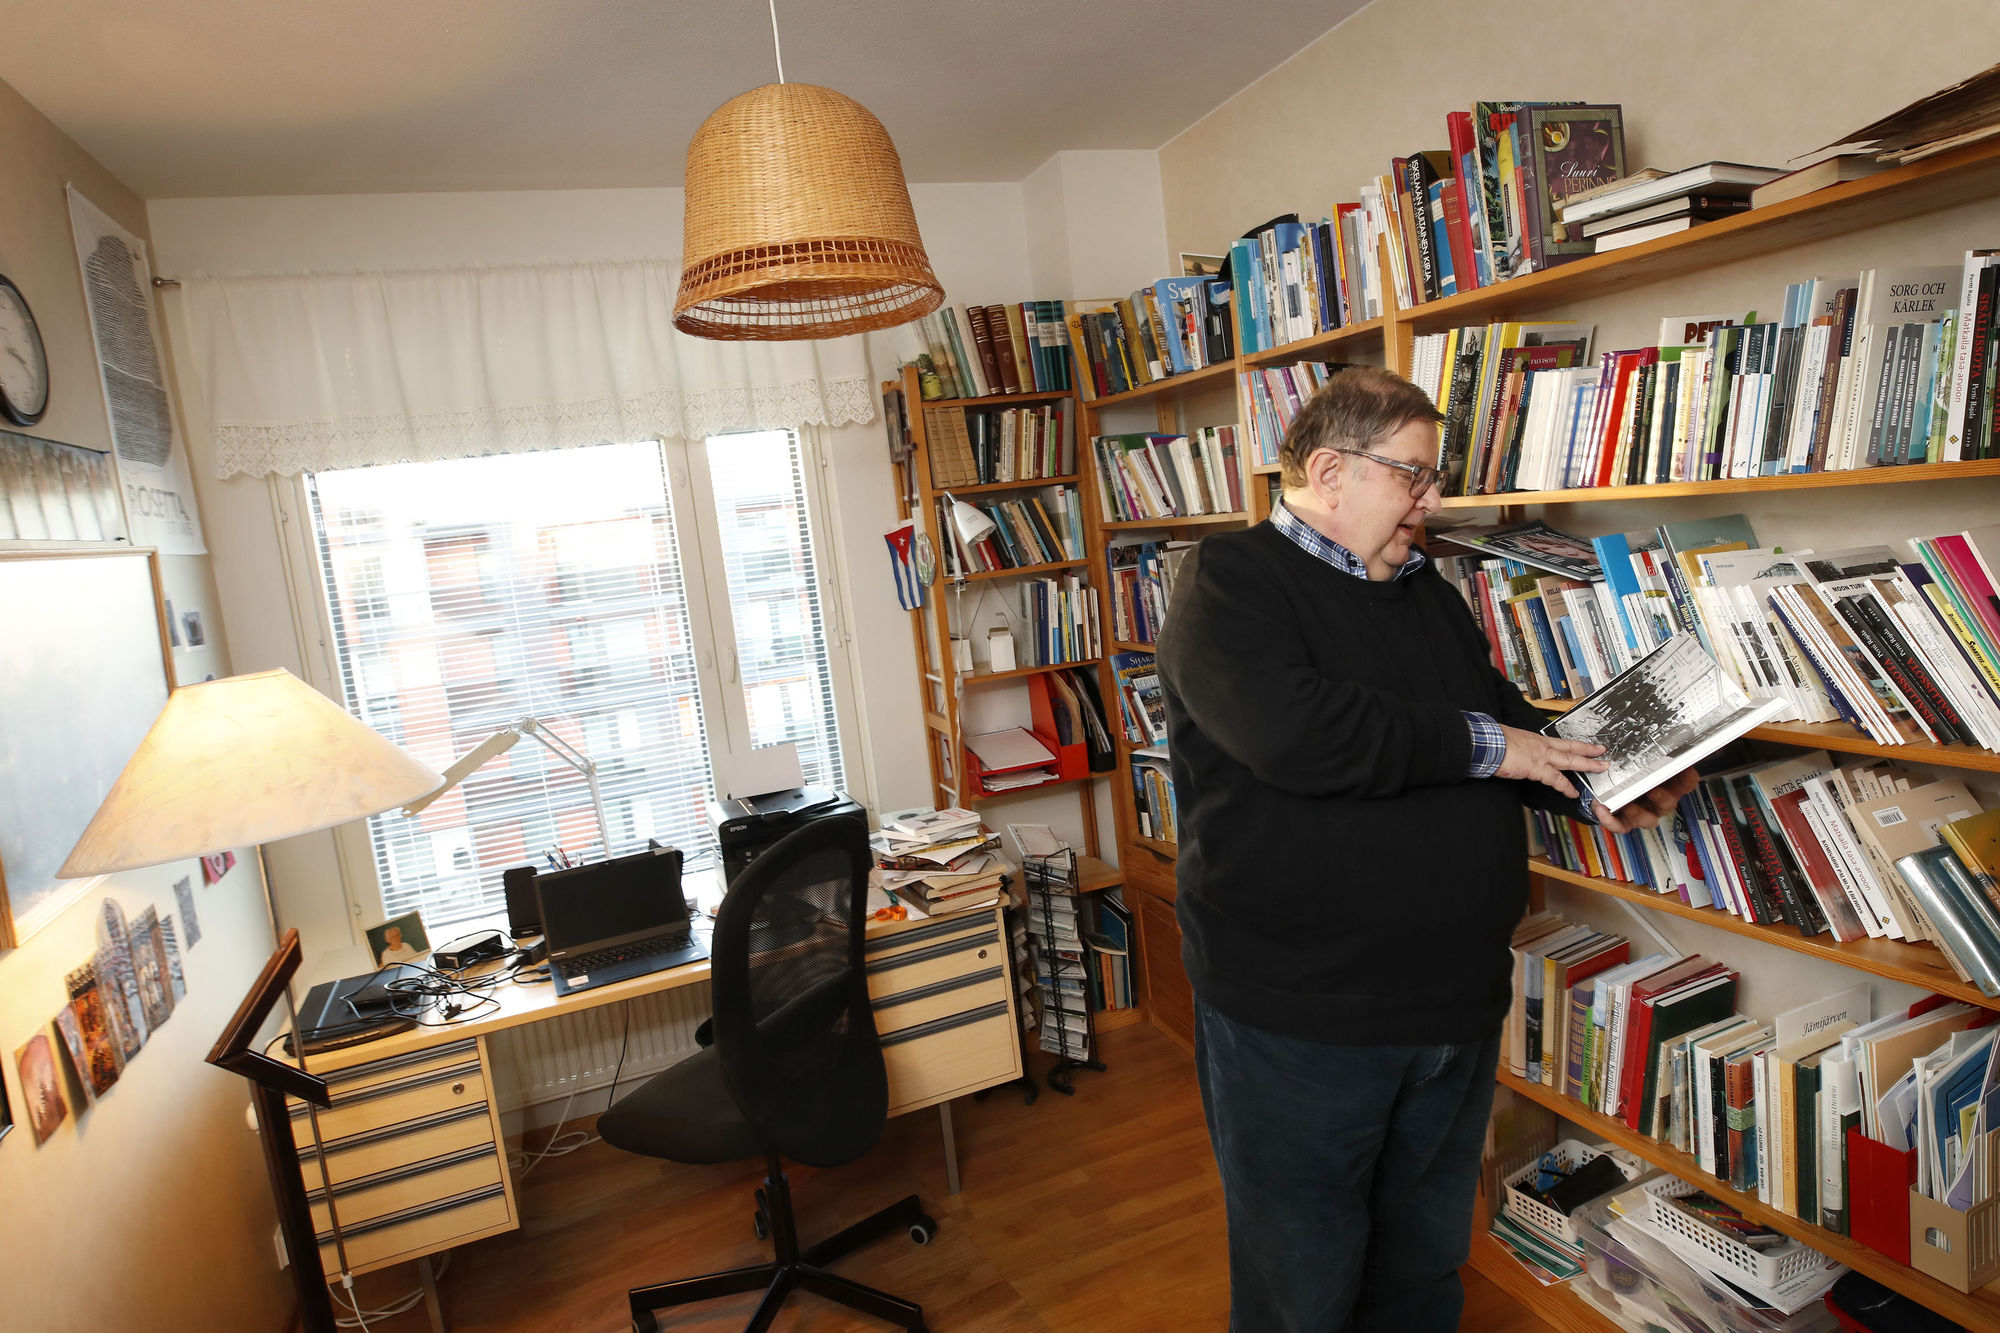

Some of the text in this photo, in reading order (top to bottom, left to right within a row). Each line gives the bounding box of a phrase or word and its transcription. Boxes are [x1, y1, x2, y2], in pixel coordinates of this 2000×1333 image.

[1411, 159, 1423, 204] ISKELMÄN
[1560, 161, 1600, 178] Suuri
[1416, 206, 1428, 254] KULTAINEN
[1422, 256, 1432, 281] KIRJA
[1890, 282, 1946, 297] SORG OCH
[1893, 299, 1936, 314] KÄRLEK
[1961, 312, 1970, 350] Matkalla
[1971, 292, 1990, 378] SISÄLLISSOTA
[1809, 359, 1820, 388] Robinson
[1954, 352, 1967, 403] tasa-arvoon
[1970, 383, 1978, 399] Pertti
[1967, 400, 1976, 419] Rajala
[1678, 602, 1692, 622] Tähtiä
[1684, 594, 1702, 625] HISTORIA
[1859, 628, 1873, 645] Rajala
[1869, 642, 1883, 658] Pertti
[1882, 627, 1896, 644] Rajala
[1892, 641, 1906, 657] Pertti
[1789, 653, 1811, 692] Aarresaari
[1884, 658, 1938, 725] SISÄLLISSOTA
[1907, 657, 1960, 725] SISÄLLISSOTA
[1772, 779, 1796, 796] TÄYTTÄ
[1716, 796, 1744, 864] JATKOSOTA
[1813, 790, 1873, 891] Pertti Rajala Matkalla tasa-arvoon
[1744, 806, 1782, 874] JATKOSOTA
[1776, 874, 1789, 890] Pertti
[1783, 888, 1796, 905] Rajala
[1738, 863, 1750, 879] Pertti
[1820, 838, 1841, 869] KOMISARIO
[1836, 868, 1852, 890] PALMUN
[1847, 889, 1865, 914] EREHDYS
[1743, 878, 1756, 894] Rajala
[1611, 1001, 1622, 1032] Pirttinen
[1801, 1010, 1848, 1037] Jämijärven
[1605, 1063, 1616, 1104] Karstulassa
